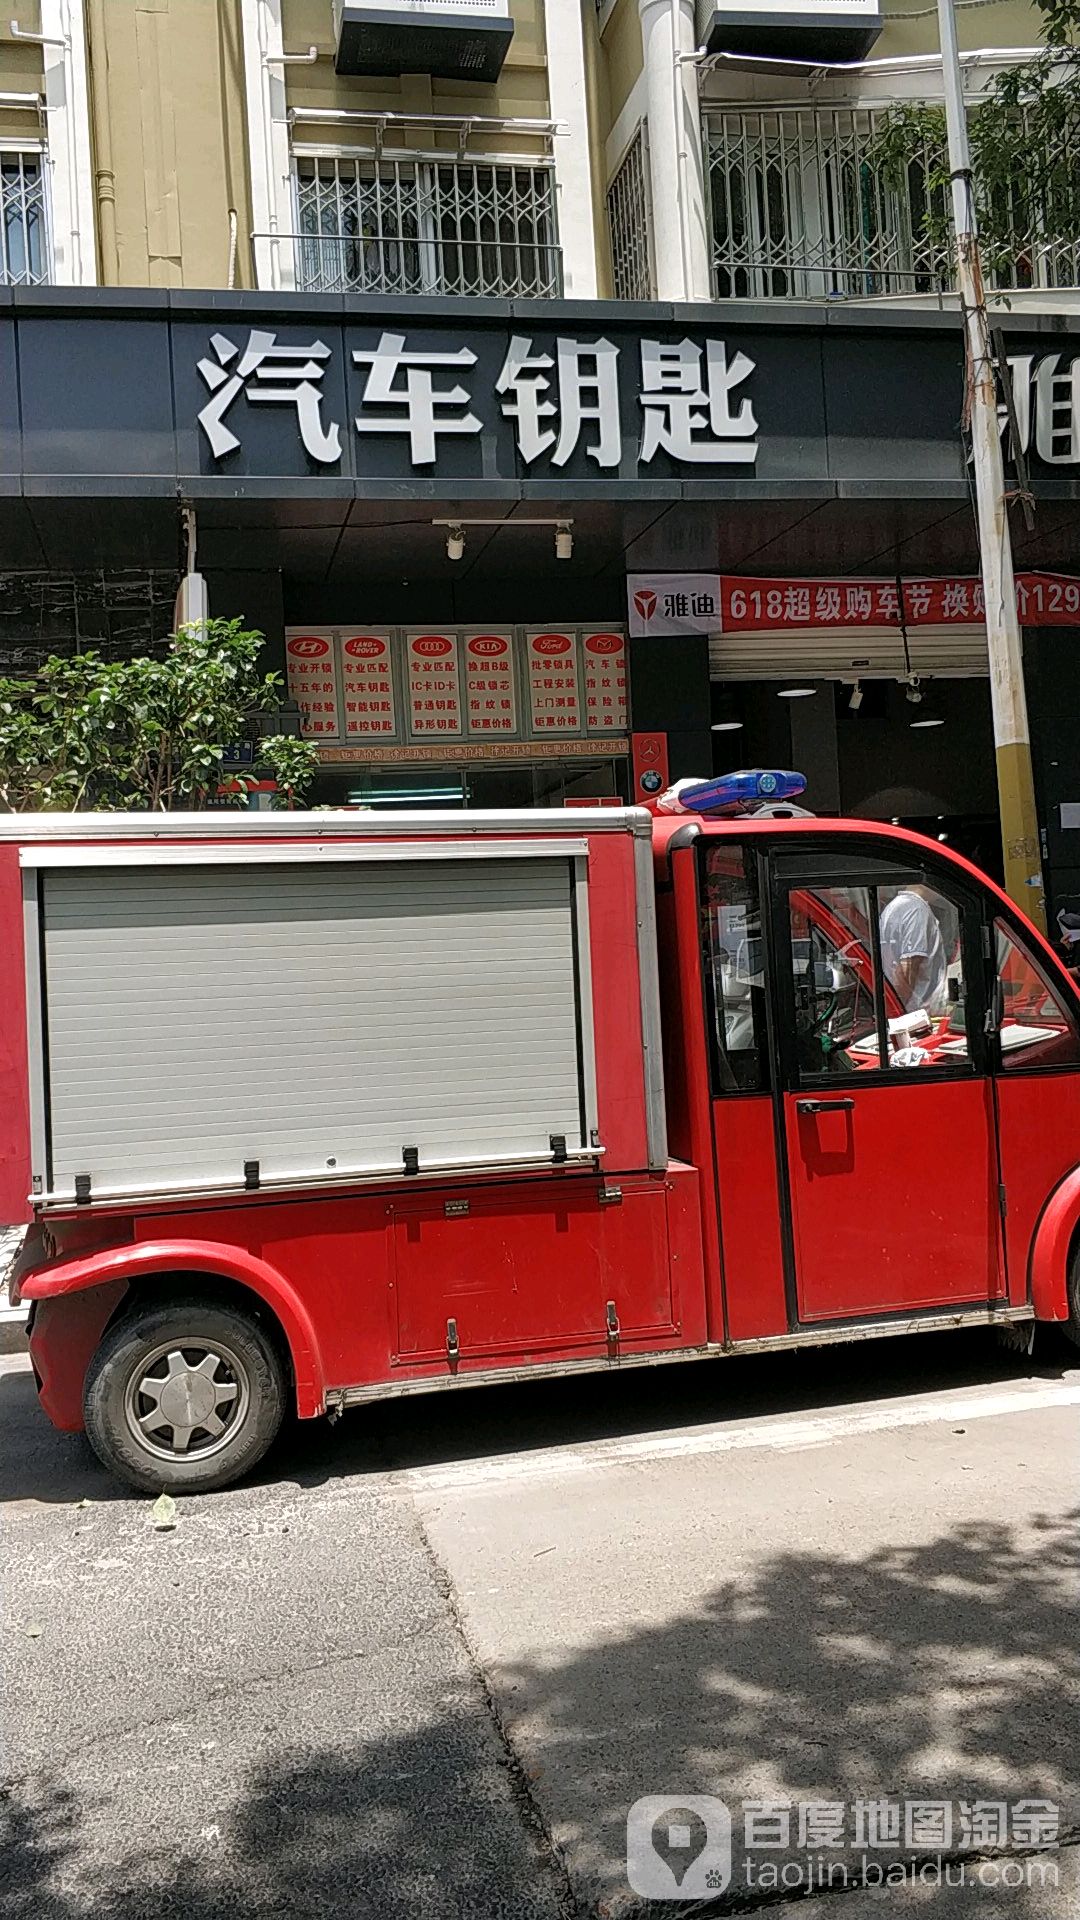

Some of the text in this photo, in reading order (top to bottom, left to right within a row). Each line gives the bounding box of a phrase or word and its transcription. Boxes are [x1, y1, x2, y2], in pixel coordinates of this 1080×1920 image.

[196, 330, 759, 466] 汽车钥匙
[663, 593, 716, 617] 雅迪
[730, 585, 933, 620] 618超级购车节
[540, 639, 563, 649] Ford
[288, 662, 332, 673] 专业开锁
[344, 662, 388, 673] 专业匹配
[411, 661, 455, 672] 专业匹配
[288, 682, 333, 693] 十五年的
[345, 682, 390, 693] 汽车钥匙
[532, 678, 575, 688] 工程安装
[301, 701, 334, 712] 作经验
[346, 701, 391, 712] 智能钥匙
[413, 699, 457, 710] 普通钥匙
[534, 697, 576, 708] 上门测量
[302, 721, 335, 731] 心服务
[347, 720, 392, 731] 遥控钥匙
[414, 718, 457, 729] 异形钥匙
